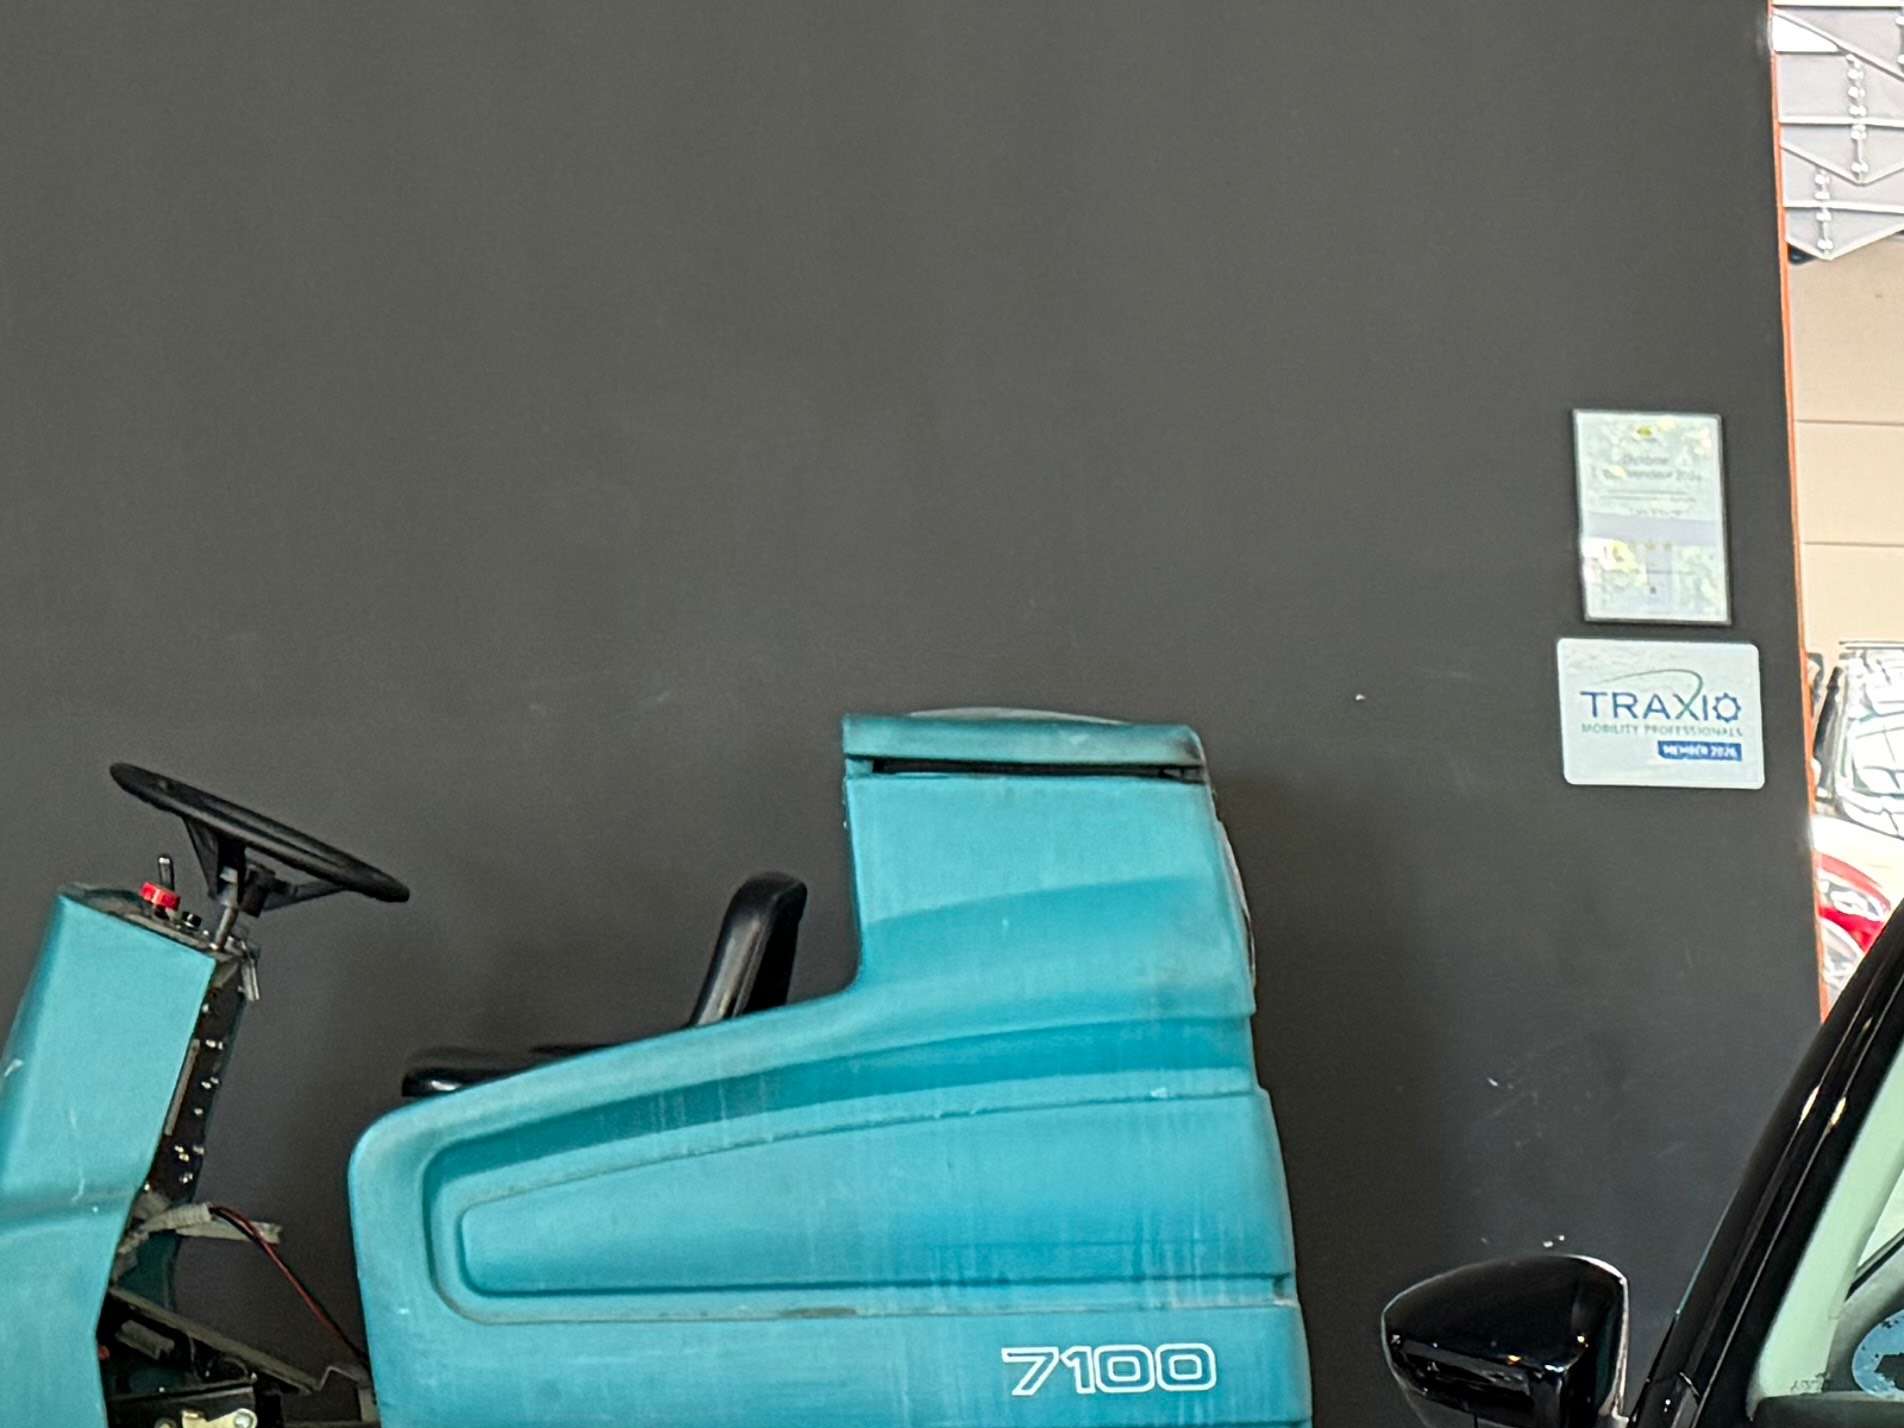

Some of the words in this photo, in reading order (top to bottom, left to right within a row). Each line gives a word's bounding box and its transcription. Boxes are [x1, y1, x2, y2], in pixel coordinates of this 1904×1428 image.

[1580, 691, 1742, 723] TRAXIO
[1581, 723, 1639, 735] MOBILITY
[1644, 724, 1743, 737] PROFESSIONALS
[1001, 1343, 1217, 1396] 7100
